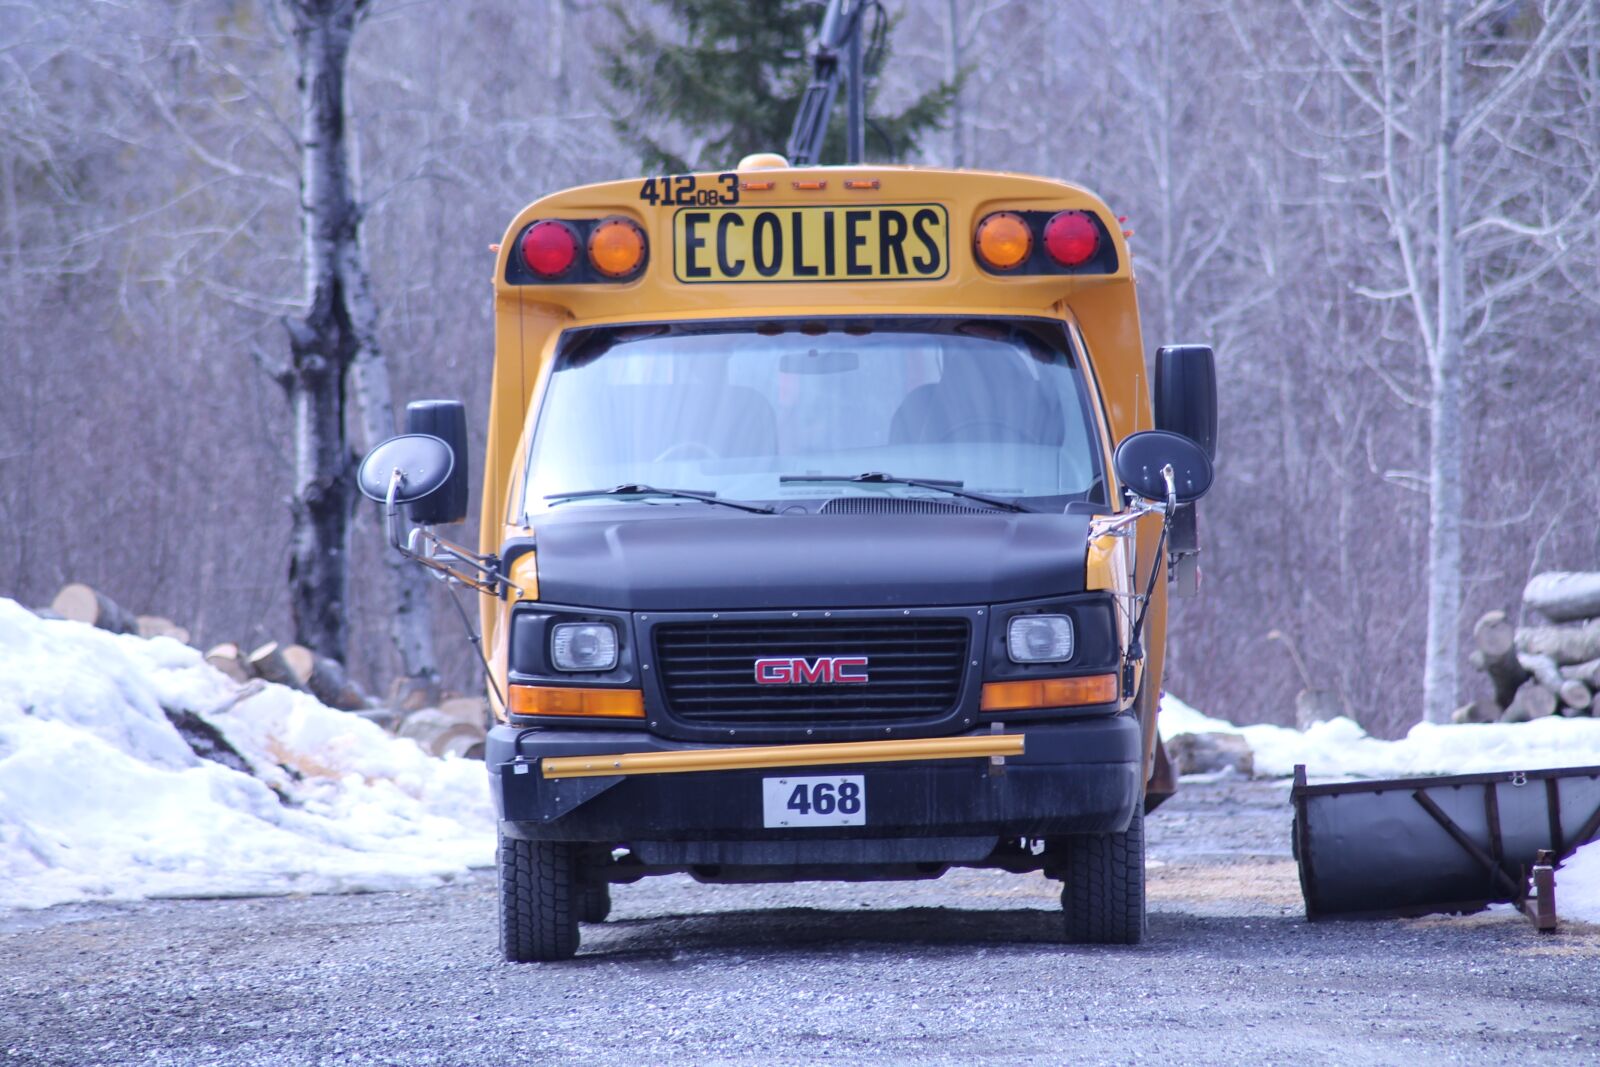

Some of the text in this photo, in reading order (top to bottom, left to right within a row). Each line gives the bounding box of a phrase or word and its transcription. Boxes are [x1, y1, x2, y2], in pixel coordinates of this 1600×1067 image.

[685, 209, 941, 278] ECOLIERS
[755, 657, 868, 684] GMC
[787, 782, 861, 815] 468
